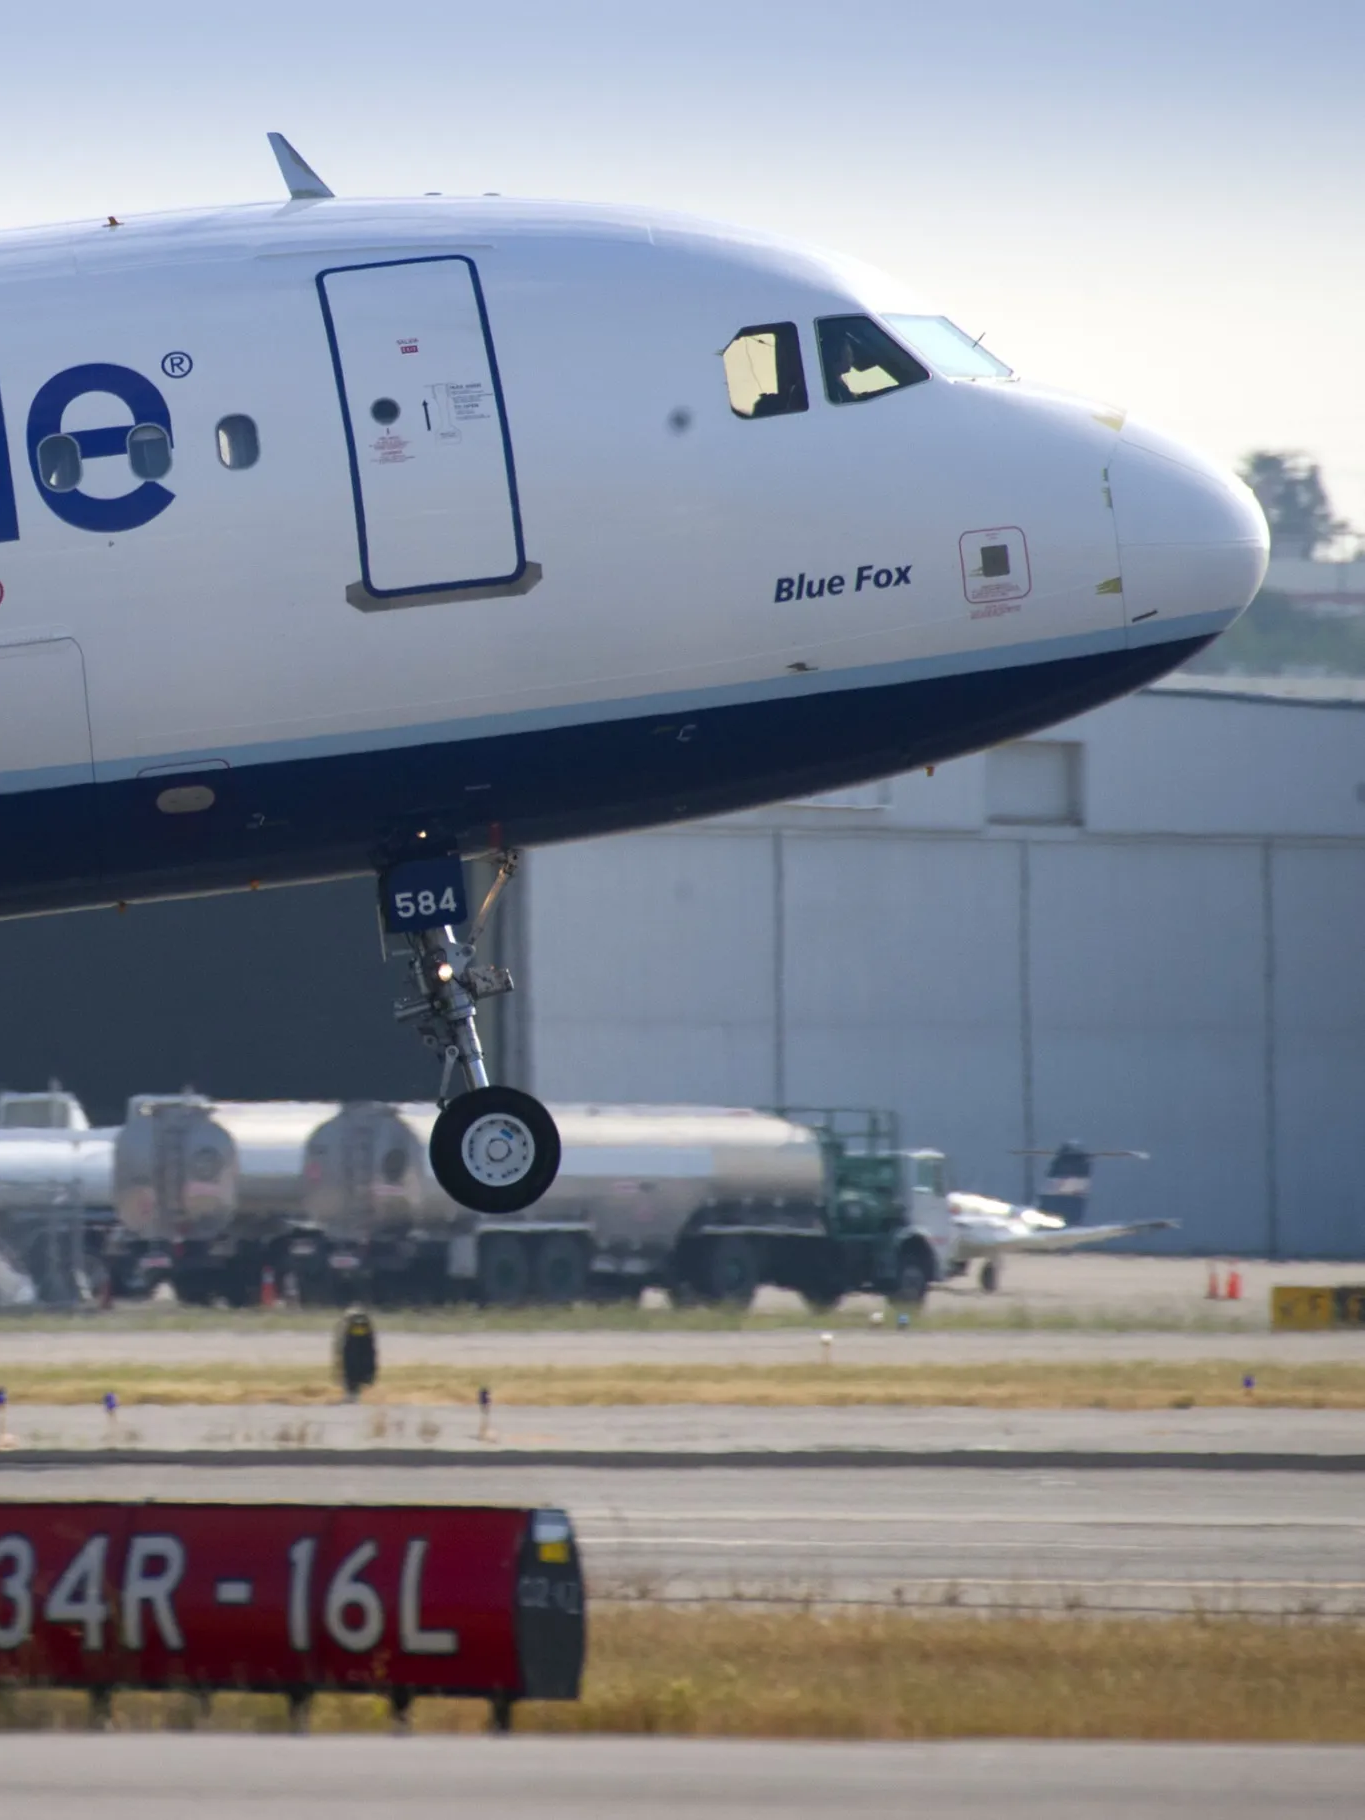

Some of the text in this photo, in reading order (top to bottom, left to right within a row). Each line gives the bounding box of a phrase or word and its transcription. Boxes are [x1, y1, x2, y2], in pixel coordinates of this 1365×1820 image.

[774, 564, 913, 603] Blue Fox
[395, 886, 458, 918] 584
